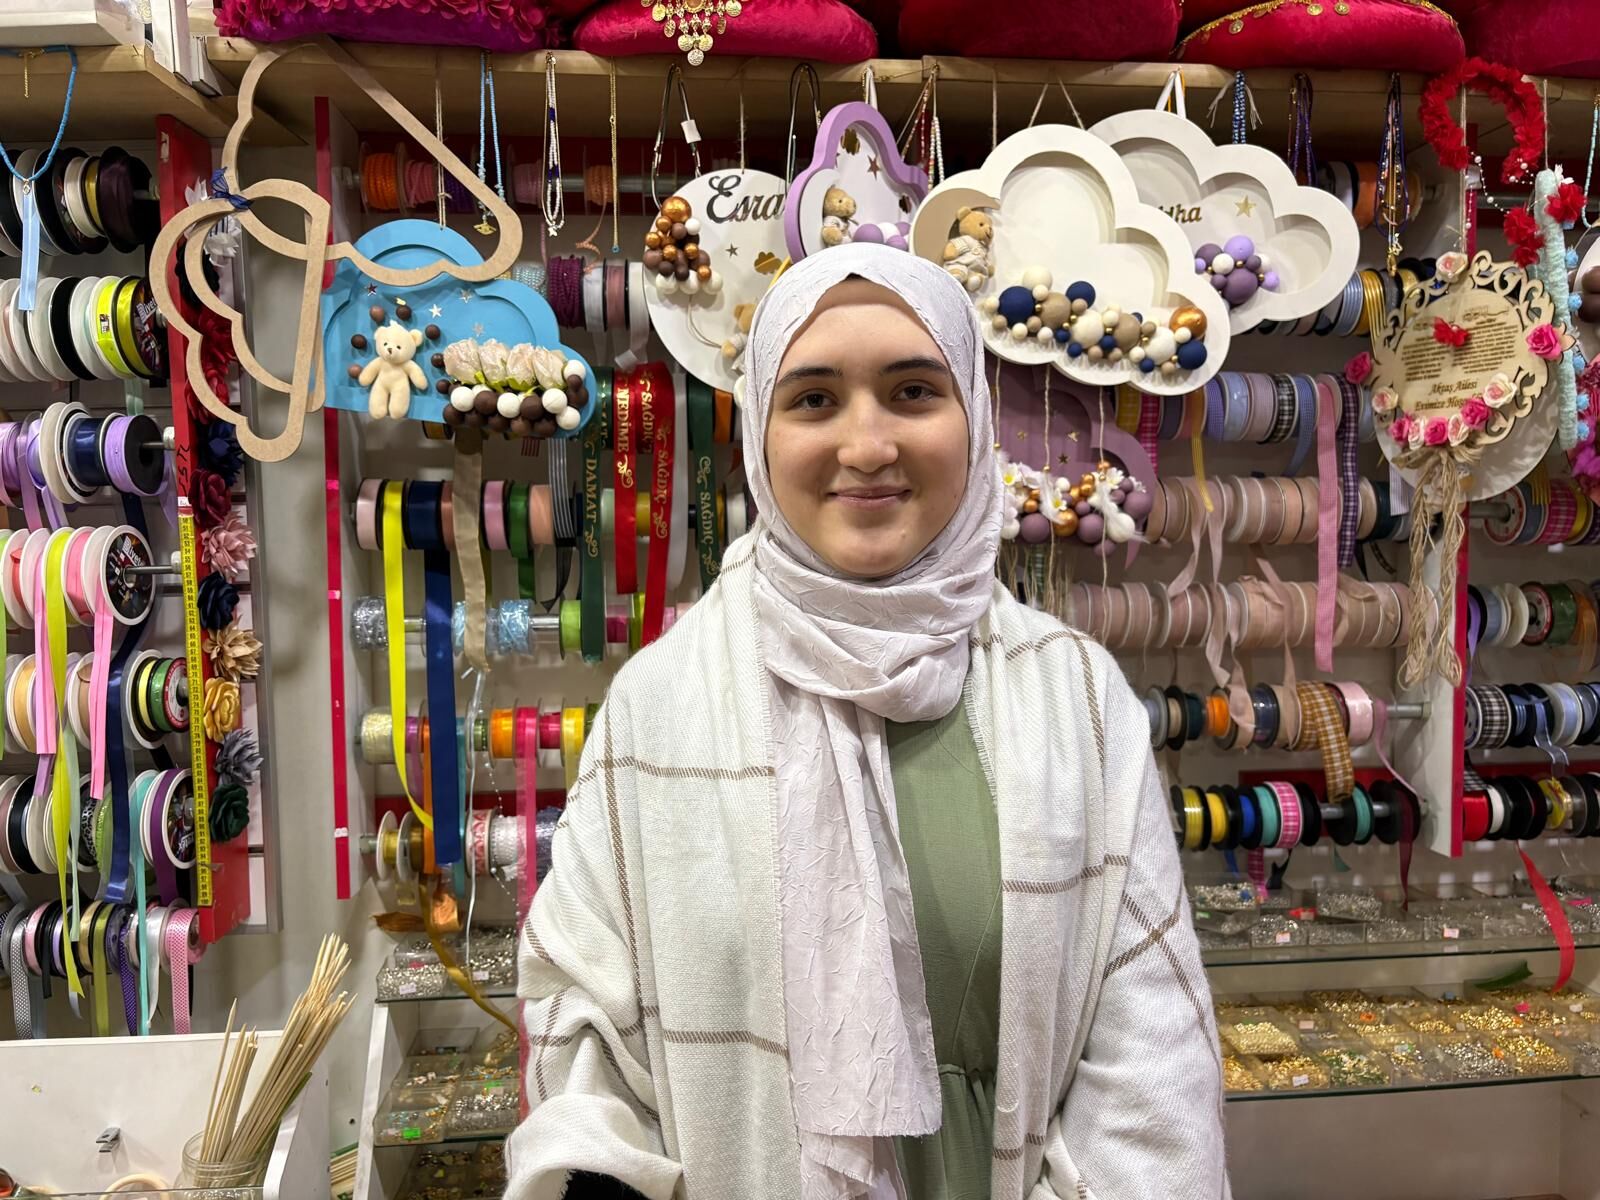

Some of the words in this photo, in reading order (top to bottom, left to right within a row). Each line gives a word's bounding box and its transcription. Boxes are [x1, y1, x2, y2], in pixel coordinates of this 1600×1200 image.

[706, 174, 785, 224] Esra
[585, 458, 597, 524] DAMAT
[655, 451, 669, 504] SAĞDIÇ
[700, 491, 714, 545] SAĞDIÇ
